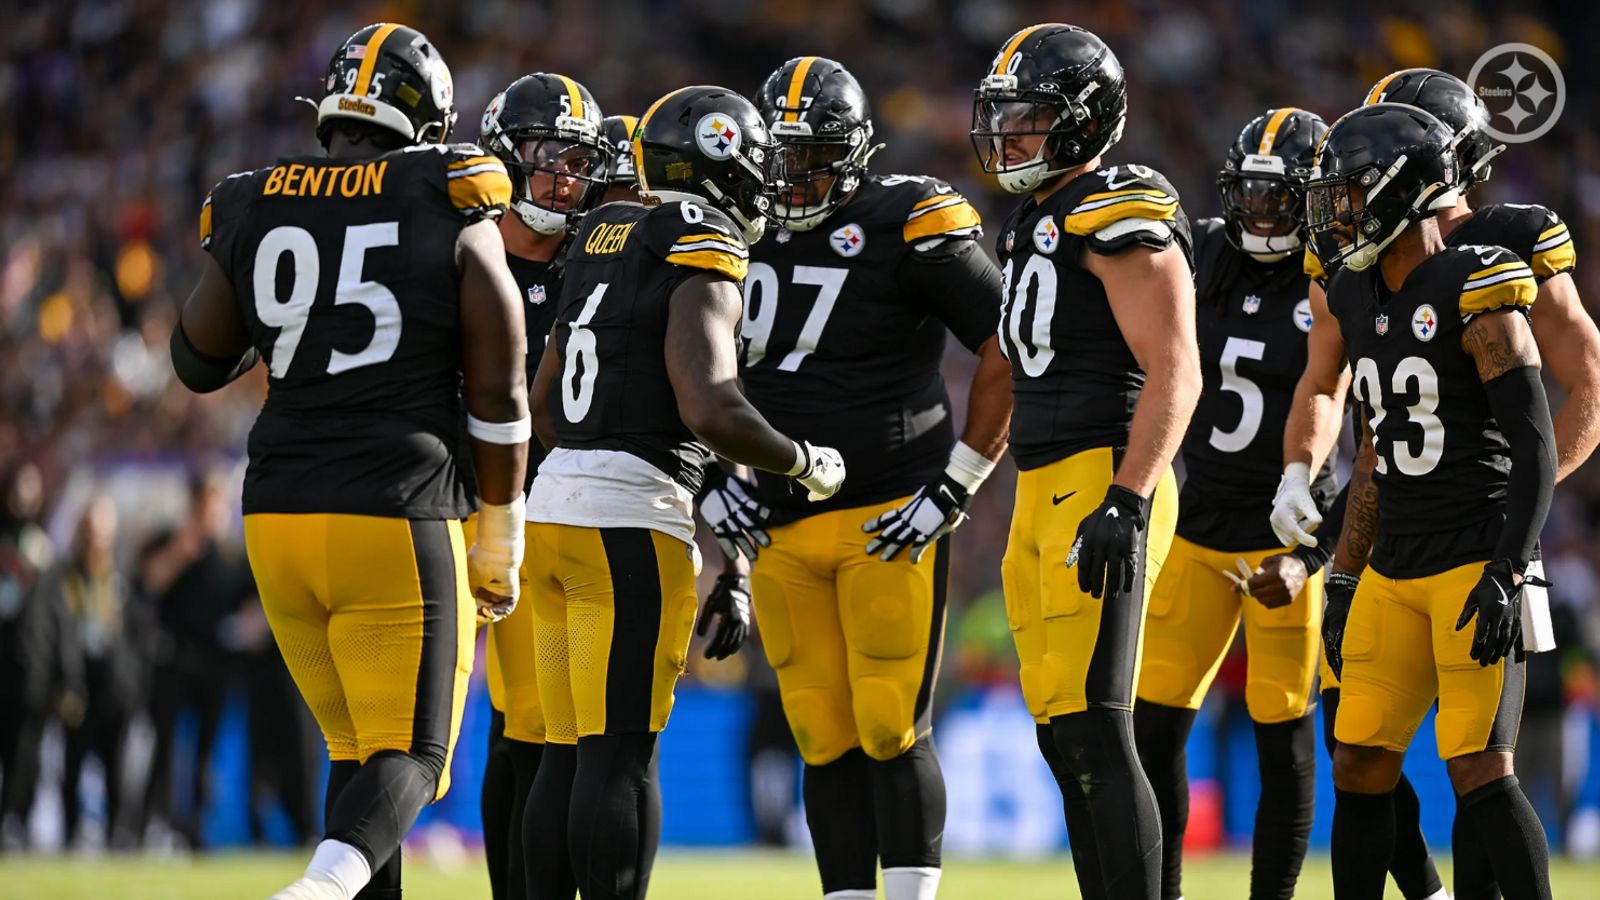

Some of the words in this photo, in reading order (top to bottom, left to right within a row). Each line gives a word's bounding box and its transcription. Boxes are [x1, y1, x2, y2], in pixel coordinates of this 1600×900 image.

[344, 68, 386, 99] 95
[338, 97, 376, 116] Steelers
[775, 95, 814, 121] 97
[1258, 133, 1275, 155] 5
[264, 161, 388, 197] BENTON
[680, 201, 704, 224] 6
[585, 221, 638, 255] QUEEN
[254, 222, 402, 378] 95
[741, 262, 849, 371] 97
[562, 283, 609, 423] 6
[1208, 337, 1266, 452] 5
[1353, 356, 1445, 476] 23
